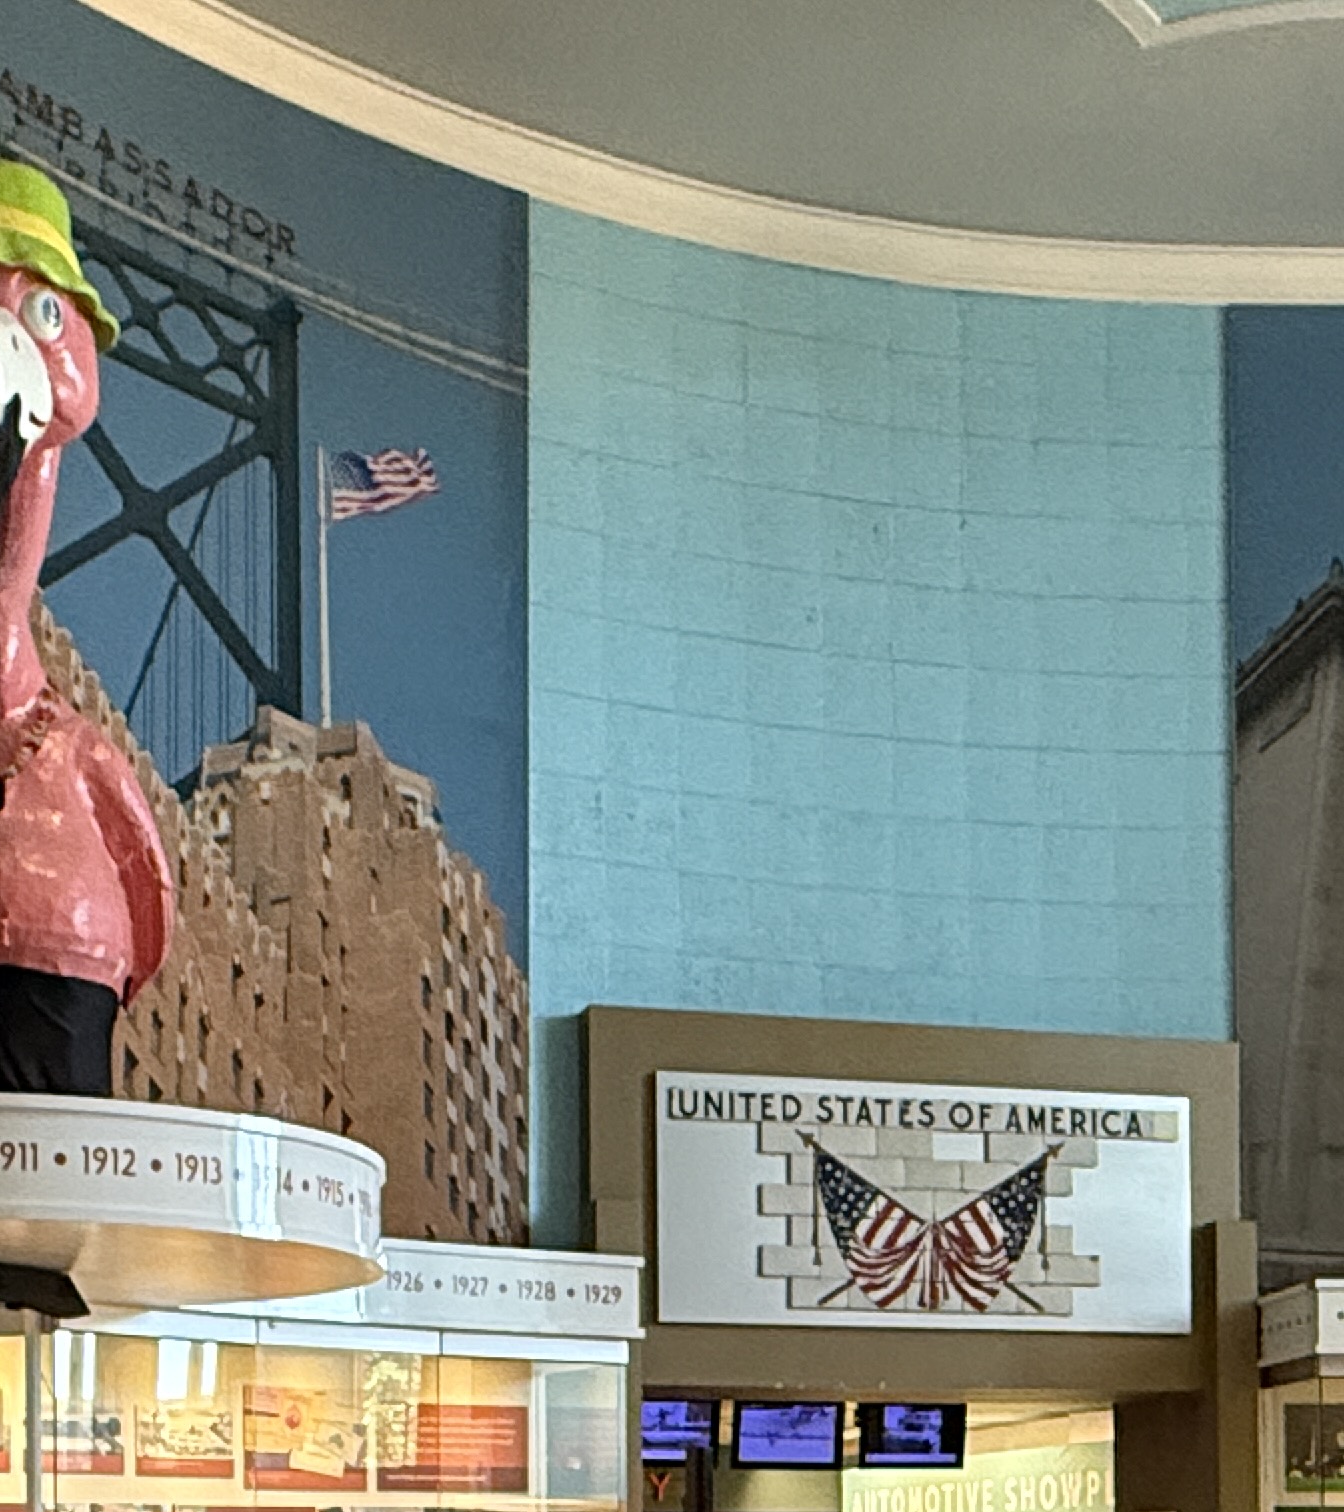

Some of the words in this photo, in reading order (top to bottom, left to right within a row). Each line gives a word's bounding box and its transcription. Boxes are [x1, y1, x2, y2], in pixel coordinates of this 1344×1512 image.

[0, 67, 297, 257] AMBASSADOR
[675, 1089, 803, 1123] UNITED
[816, 1097, 936, 1127] STATES
[948, 1101, 992, 1130] OF
[1006, 1103, 1145, 1138] AMERICA
[81, 1145, 137, 1178] 1912
[175, 1152, 223, 1185] 1913
[315, 1174, 345, 1208] 1915
[385, 1270, 424, 1294] 1926
[451, 1274, 489, 1298] 1927
[516, 1278, 557, 1302] 1928
[583, 1282, 623, 1306] 1929
